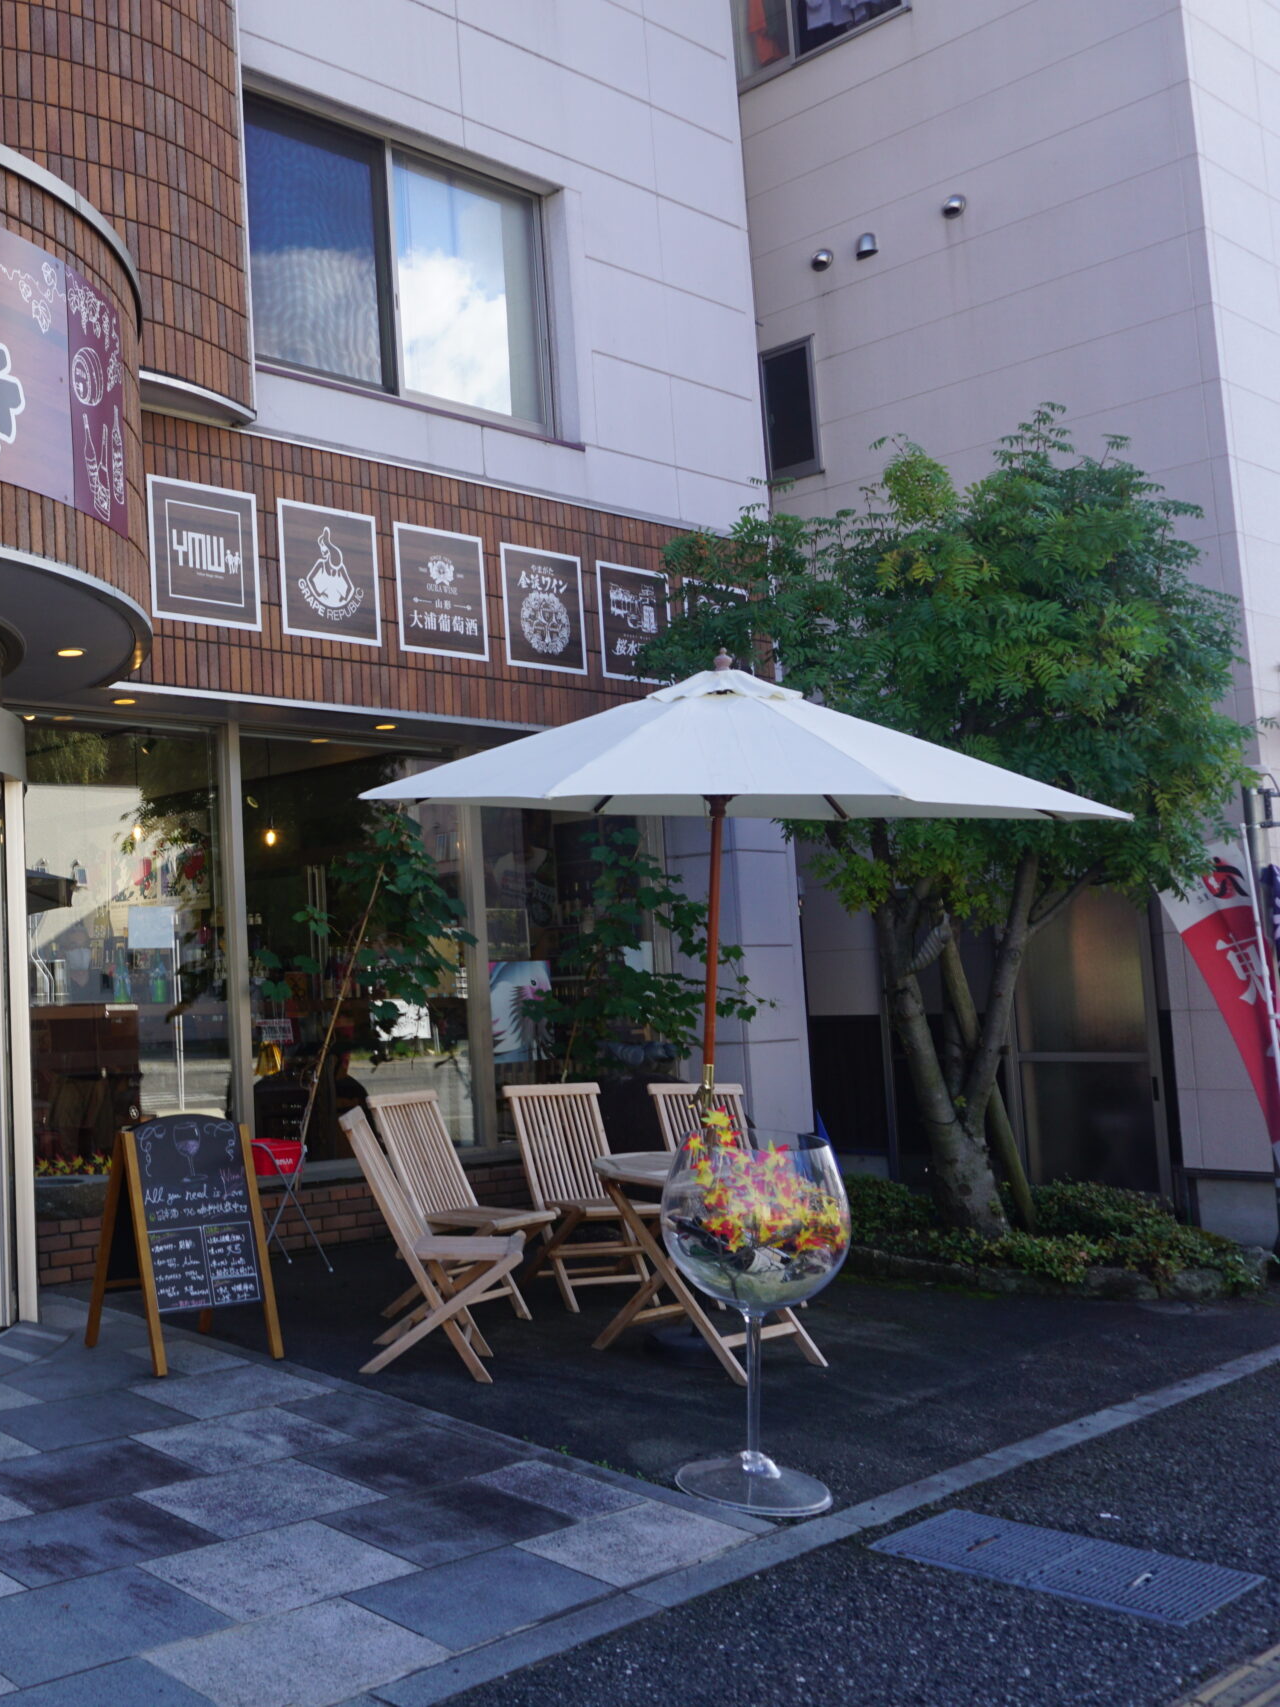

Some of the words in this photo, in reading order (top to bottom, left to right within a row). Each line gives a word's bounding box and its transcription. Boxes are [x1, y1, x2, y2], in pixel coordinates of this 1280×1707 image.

[172, 528, 226, 574] YMW
[297, 577, 325, 617] GRAPE
[326, 586, 365, 622] REPUBLIC
[409, 609, 479, 637] 大浦葡萄酒
[144, 1186, 165, 1206] All
[185, 1184, 209, 1201] need
